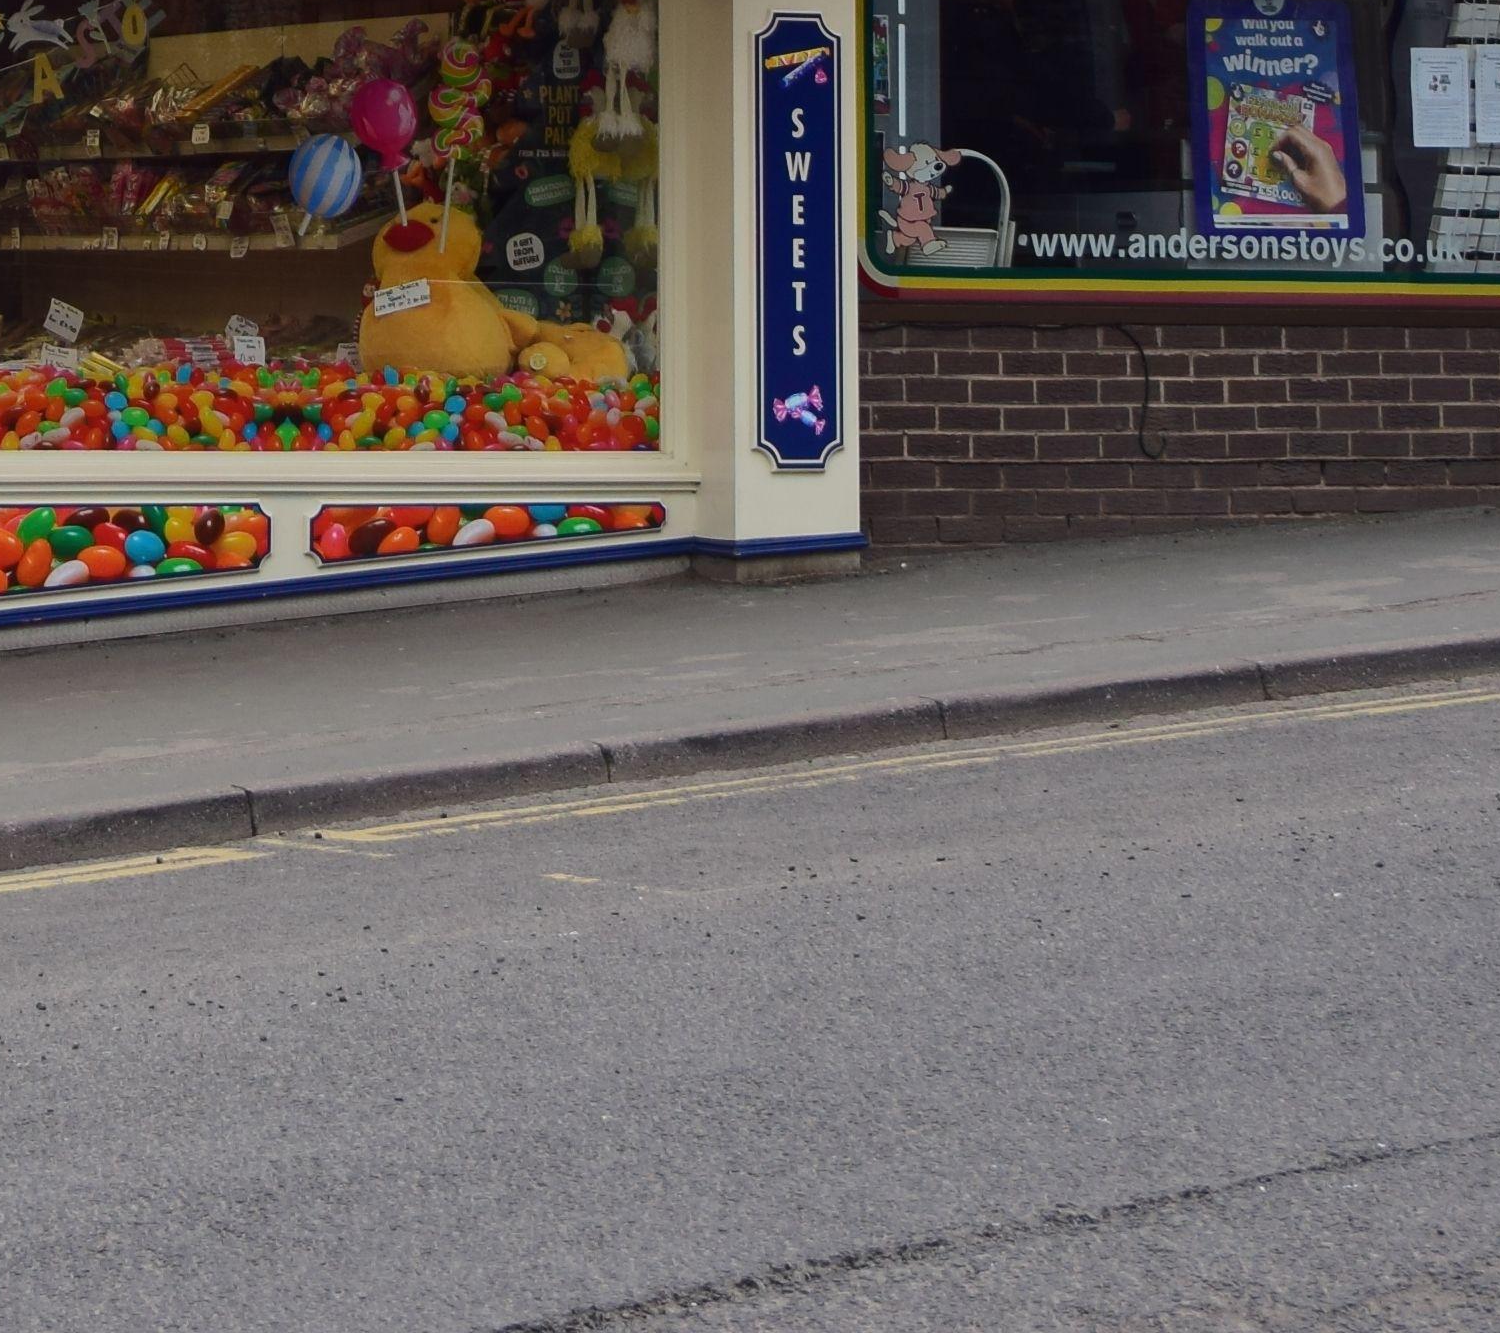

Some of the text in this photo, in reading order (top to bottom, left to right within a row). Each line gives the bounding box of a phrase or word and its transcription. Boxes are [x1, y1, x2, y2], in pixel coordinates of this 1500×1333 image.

[1270, 20, 1296, 35] you
[1234, 34, 1305, 47] walk out a
[1222, 48, 1320, 77] winner?
[539, 84, 580, 106] PLANT
[547, 106, 574, 125] POT
[785, 107, 811, 357] SWEETS
[513, 246, 535, 258] FROM
[1032, 227, 1466, 268] www.andersonstoys.co.uk
